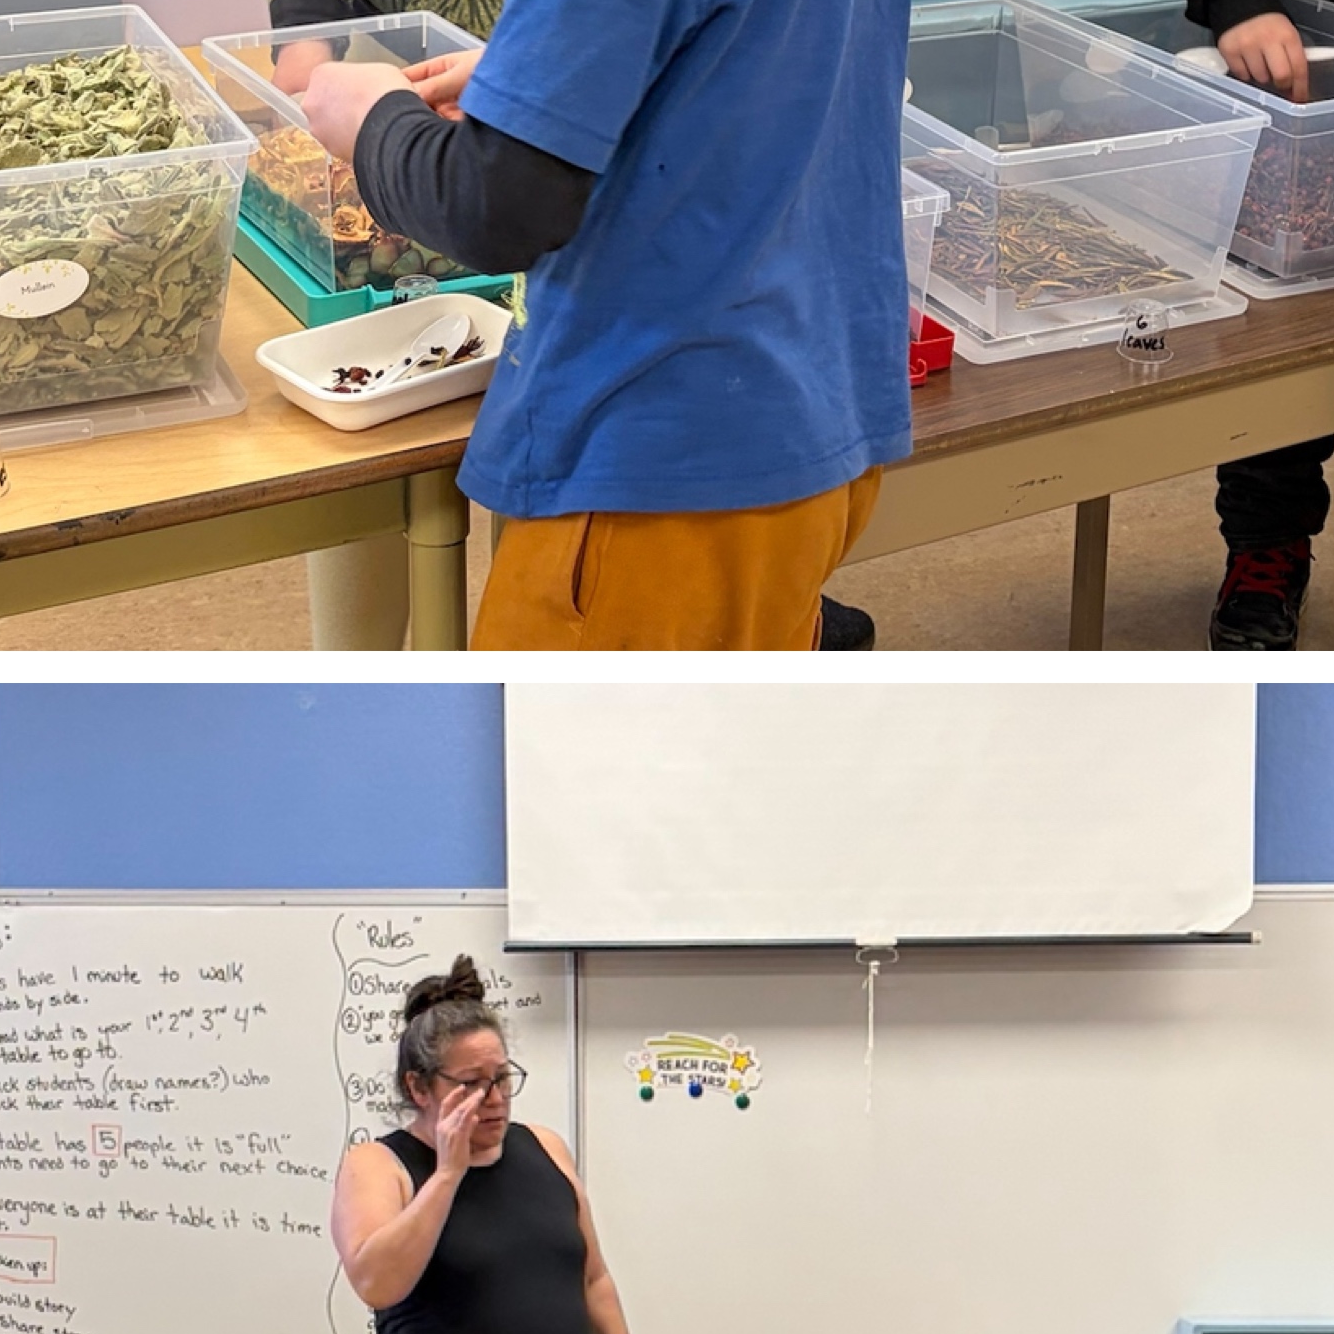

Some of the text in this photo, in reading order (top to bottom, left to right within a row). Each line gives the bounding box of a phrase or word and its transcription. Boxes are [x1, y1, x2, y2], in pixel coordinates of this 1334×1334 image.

[1136, 315, 1148, 330] 6
[18, 968, 55, 987] have
[158, 965, 180, 984] to
[199, 962, 244, 983] walk
[25, 995, 44, 1016] by
[25, 1023, 63, 1041] what
[657, 1059, 728, 1073] REACH FOR
[233, 1069, 270, 1085] who
[661, 1073, 682, 1084] THE
[55, 1132, 87, 1152] has
[99, 1131, 116, 1150] 5
[124, 1135, 176, 1158] people
[186, 1136, 204, 1152] it
[70, 1156, 90, 1168] to
[99, 1160, 118, 1178] go
[131, 1156, 148, 1169] to
[162, 1156, 207, 1173] their
[220, 1159, 266, 1175] next
[64, 1203, 79, 1217] is
[87, 1202, 107, 1219] at
[117, 1201, 159, 1221] their
[166, 1204, 216, 1229] table
[222, 1210, 240, 1228] it
[252, 1212, 269, 1232] is
[280, 1212, 322, 1237] time
